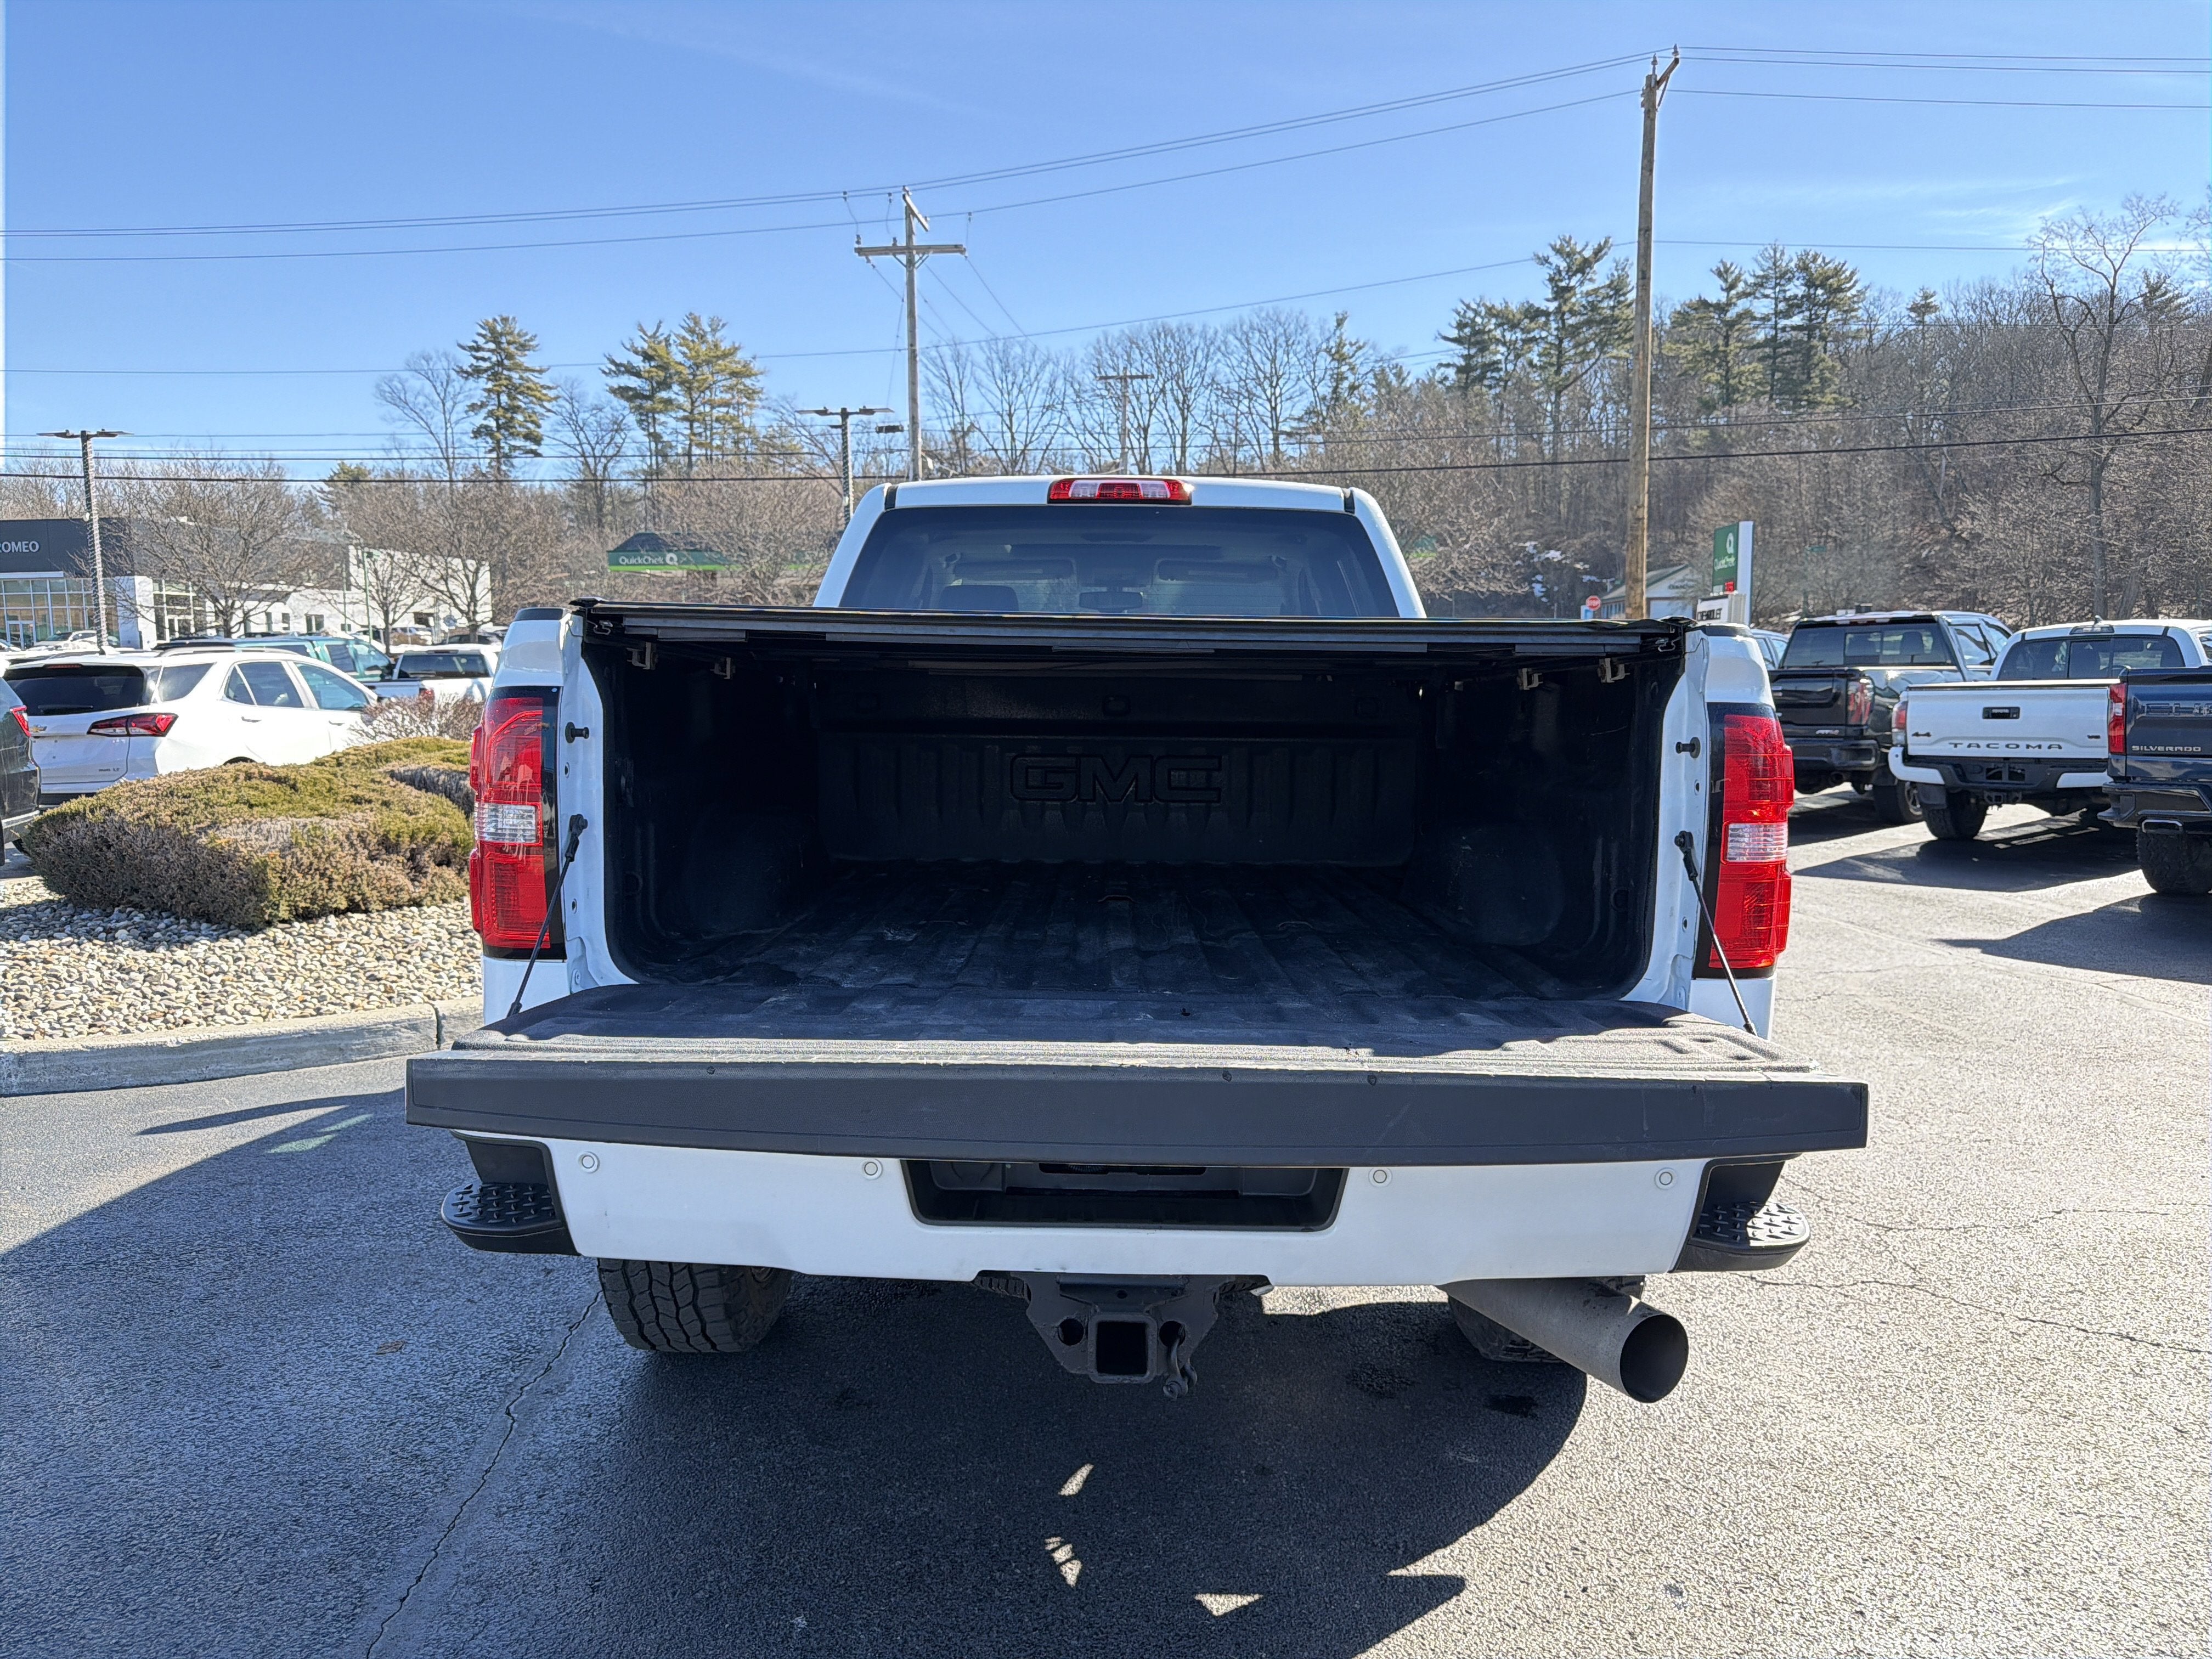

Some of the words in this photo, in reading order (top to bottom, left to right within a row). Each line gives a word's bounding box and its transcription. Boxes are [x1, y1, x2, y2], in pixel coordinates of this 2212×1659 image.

[0, 541, 40, 553] OMEO
[619, 555, 664, 565] QuickChek
[1948, 742, 2063, 750] TACOMA
[1010, 753, 1222, 803] GMC
